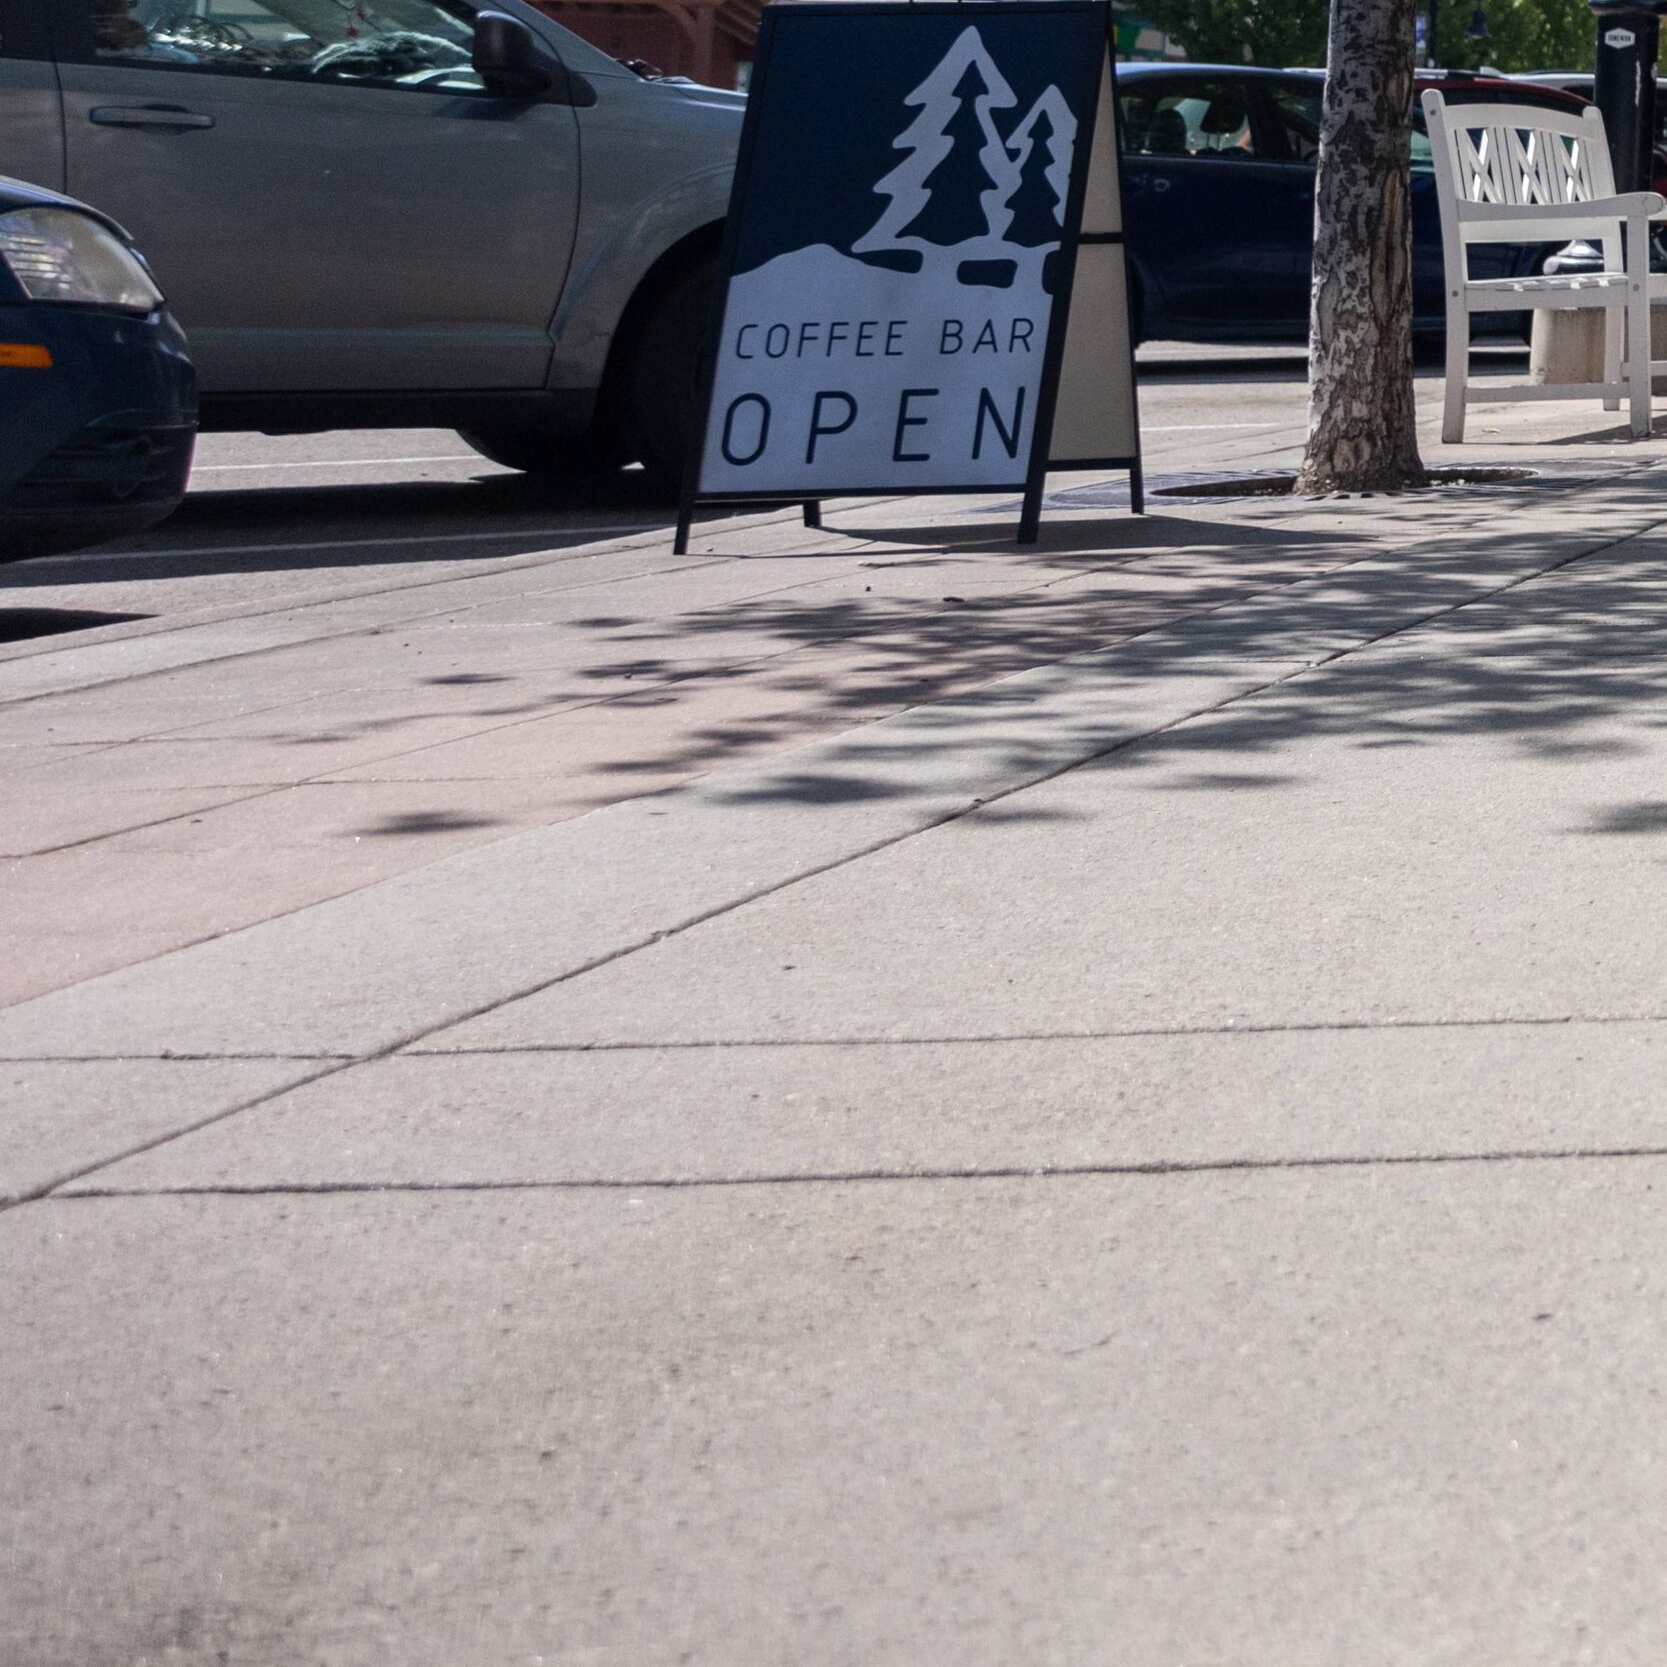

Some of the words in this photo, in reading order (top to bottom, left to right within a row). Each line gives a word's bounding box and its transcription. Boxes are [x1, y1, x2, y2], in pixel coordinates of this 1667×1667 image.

[735, 320, 908, 360] COFFEE
[939, 317, 1035, 355] BAR
[721, 386, 1027, 467] OPEN
